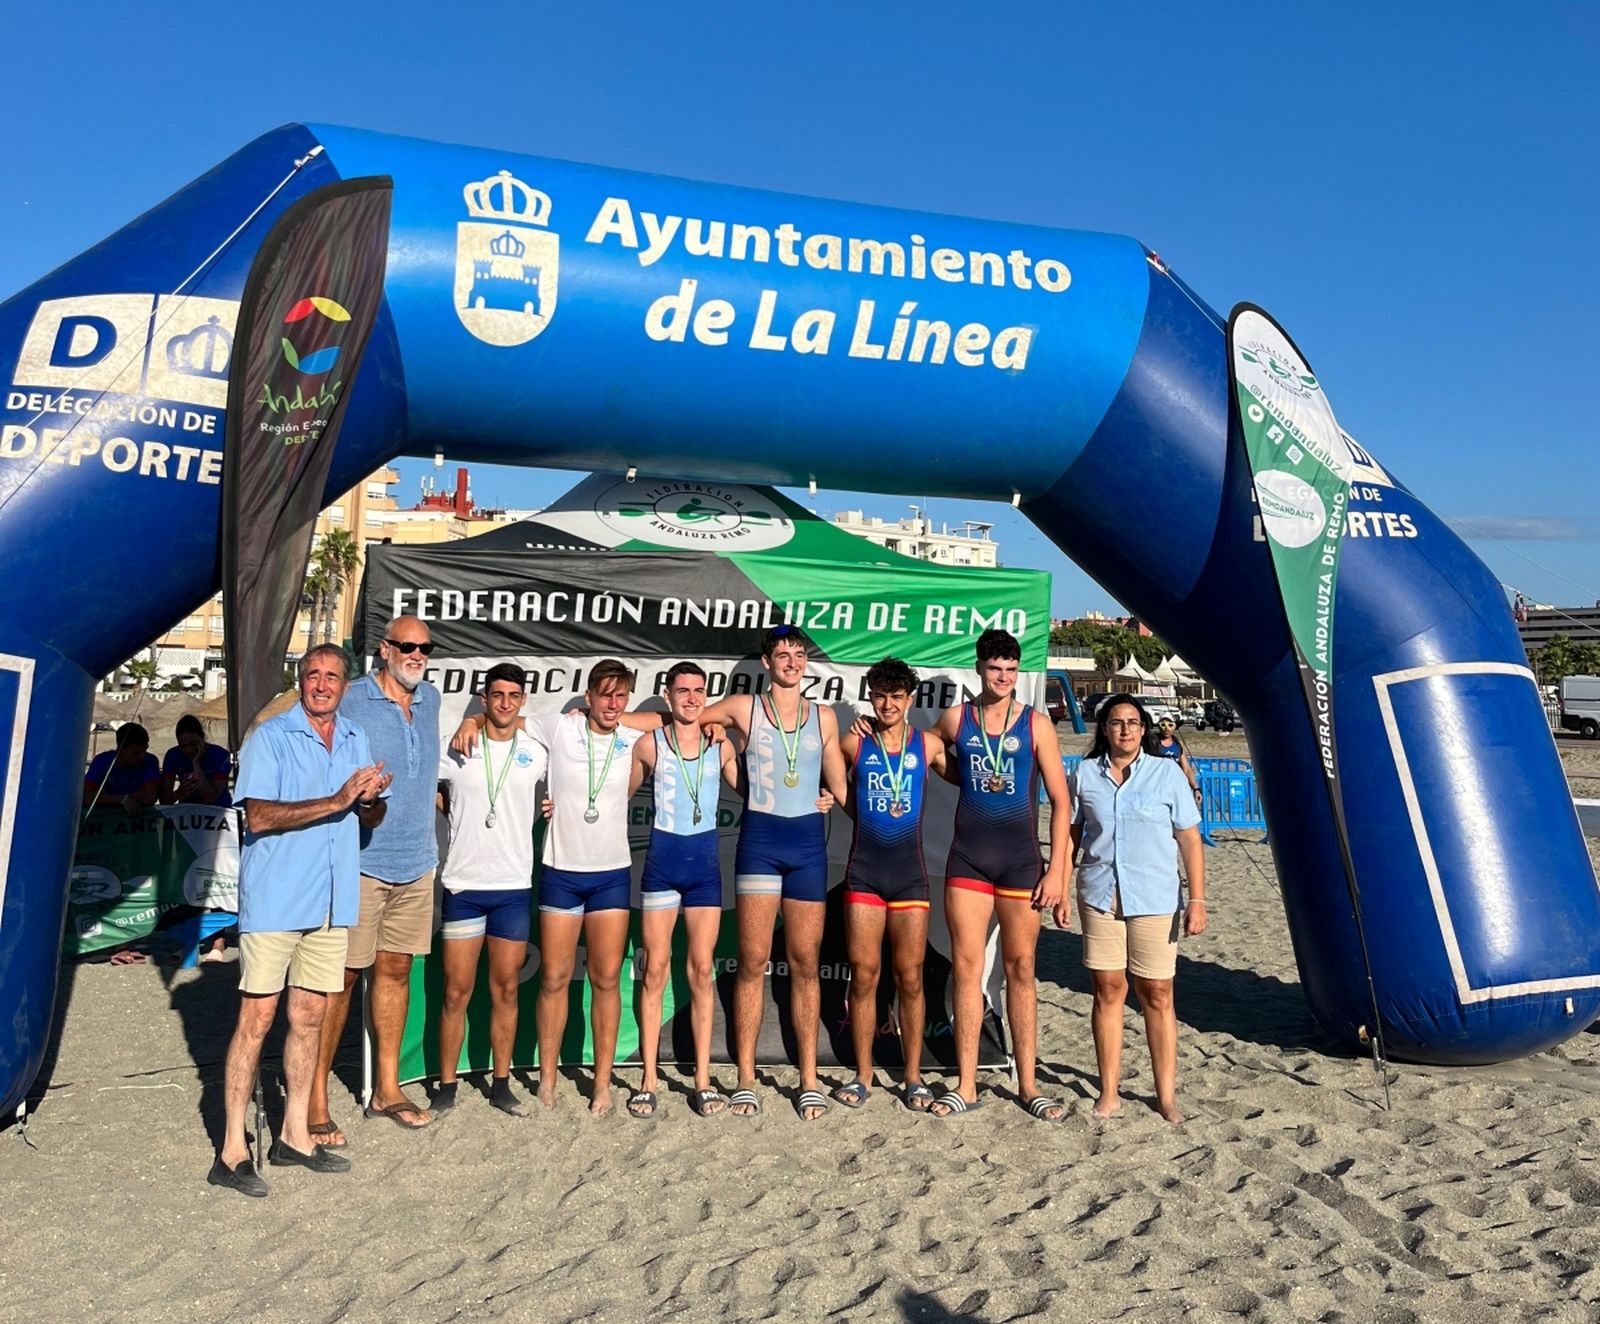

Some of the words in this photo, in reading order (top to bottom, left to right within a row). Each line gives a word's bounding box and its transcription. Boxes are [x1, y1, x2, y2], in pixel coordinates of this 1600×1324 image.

[585, 197, 1072, 293] Ayuntamiento
[644, 278, 736, 346] de
[748, 289, 837, 355] La
[847, 299, 1034, 371] Línea
[6, 392, 177, 428] DELEGACIÓN
[182, 411, 217, 434] DE
[260, 422, 300, 435] Región
[1362, 486, 1383, 502] DE
[650, 520, 717, 540] ANDALUZA
[722, 526, 752, 540] REMO
[1326, 492, 1345, 539] REMO
[1321, 543, 1336, 566] DE
[392, 587, 645, 625] FEDERACIÓN
[657, 597, 855, 630] ANDALUZA
[867, 602, 911, 632] DE
[923, 603, 1027, 638] REMO
[1315, 573, 1333, 664] ANDALUZA
[972, 778, 1016, 795] 183
[868, 798, 911, 813] 183
